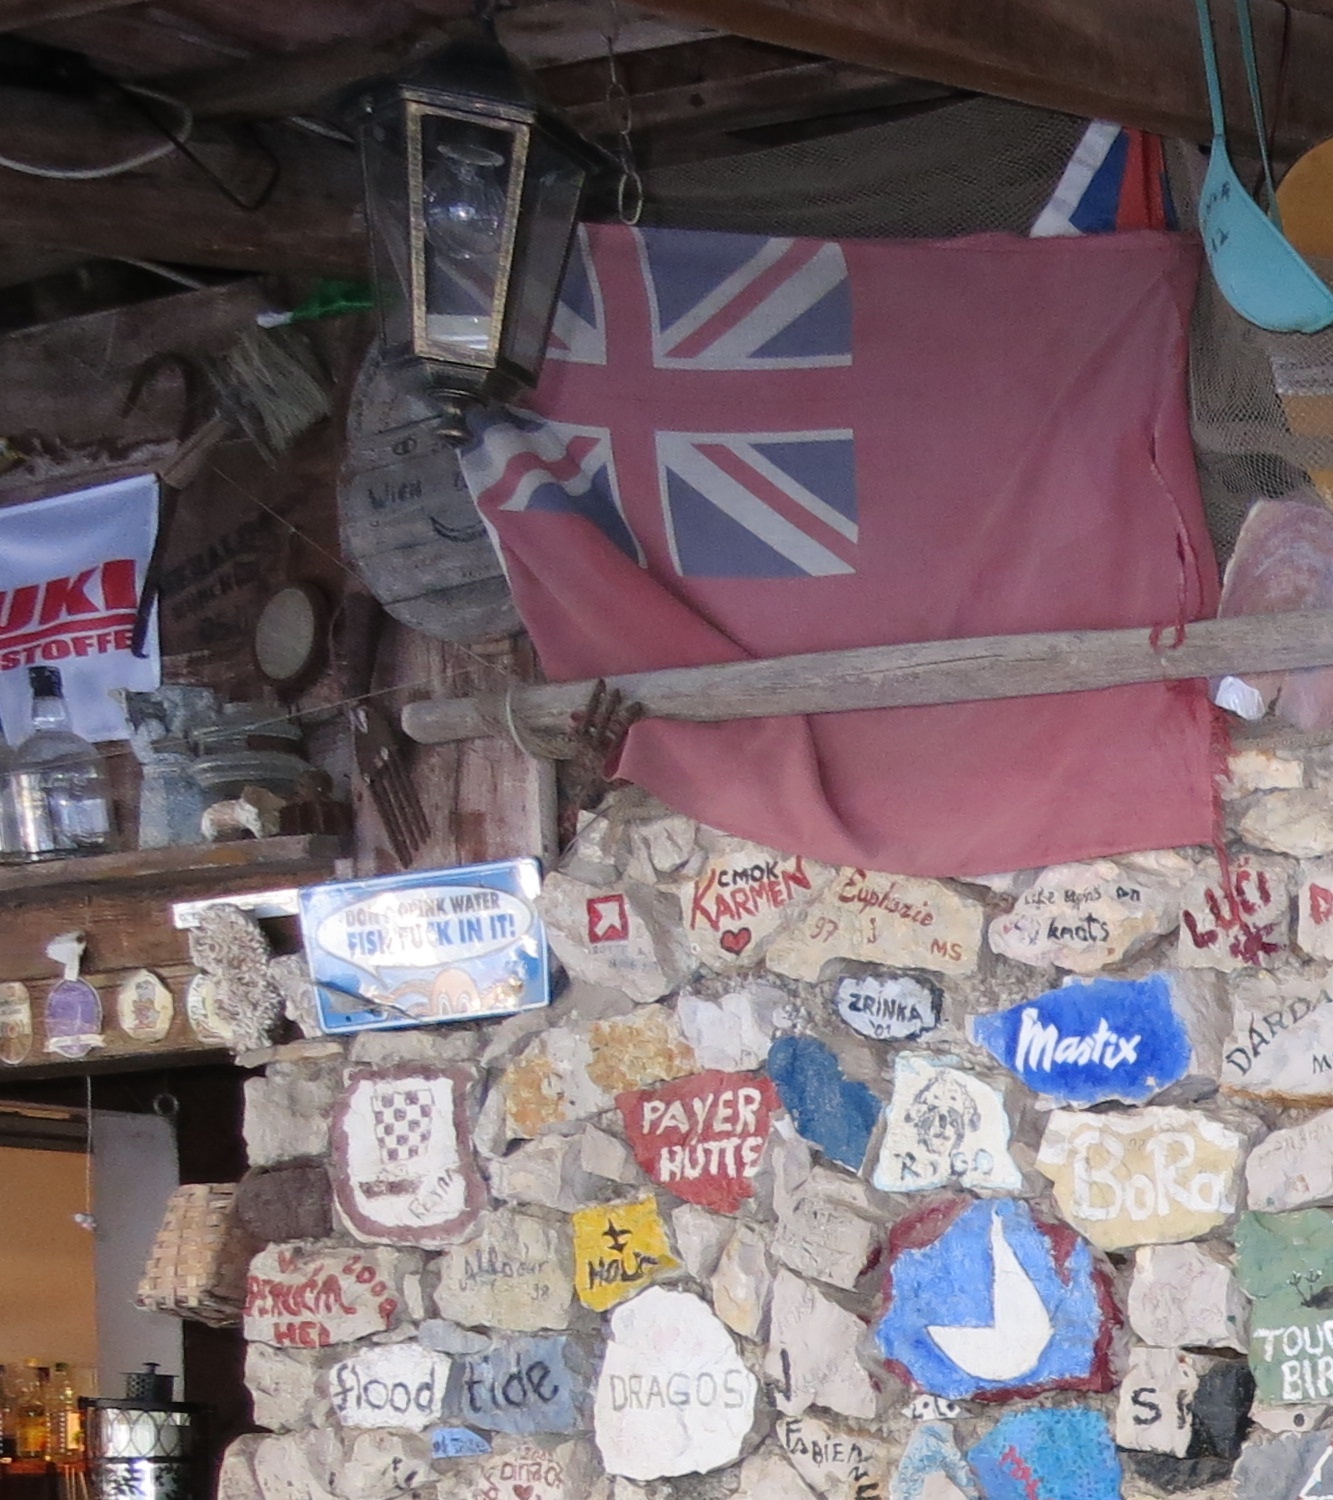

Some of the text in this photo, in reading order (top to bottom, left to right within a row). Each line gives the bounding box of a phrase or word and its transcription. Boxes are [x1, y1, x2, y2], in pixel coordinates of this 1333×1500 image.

[689, 855, 813, 933] KARMEN
[716, 860, 781, 886] CMOK
[451, 891, 500, 913] WATER
[457, 915, 484, 943] IN
[491, 912, 517, 939] IT!
[847, 990, 927, 1026] ZRINKA
[1013, 1007, 1143, 1074] Mastix
[641, 1086, 763, 1136] PAYER
[332, 1356, 439, 1414] flood
[465, 1351, 560, 1414] tide
[609, 1367, 750, 1412] DRAGOS
